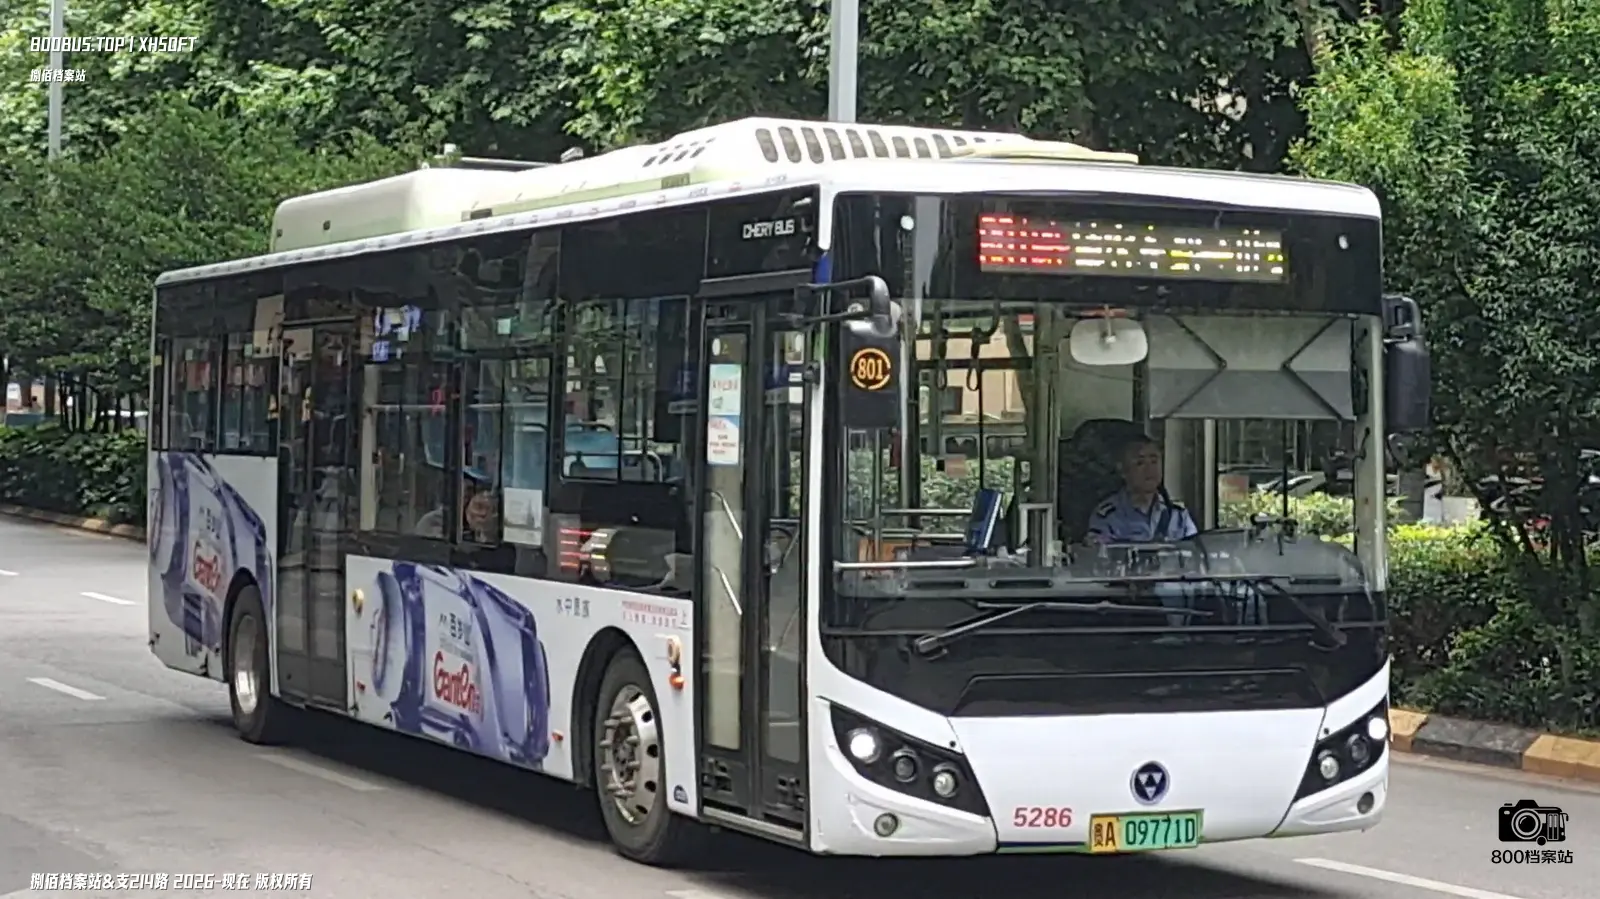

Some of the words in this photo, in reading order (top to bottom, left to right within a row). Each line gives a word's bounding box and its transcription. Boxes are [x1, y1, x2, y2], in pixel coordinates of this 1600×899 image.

[742, 221, 774, 239] CHERY
[774, 218, 796, 236] BUS
[857, 357, 883, 380] 801
[1013, 806, 1073, 828] 5286
[1124, 817, 1197, 846] 09771D
